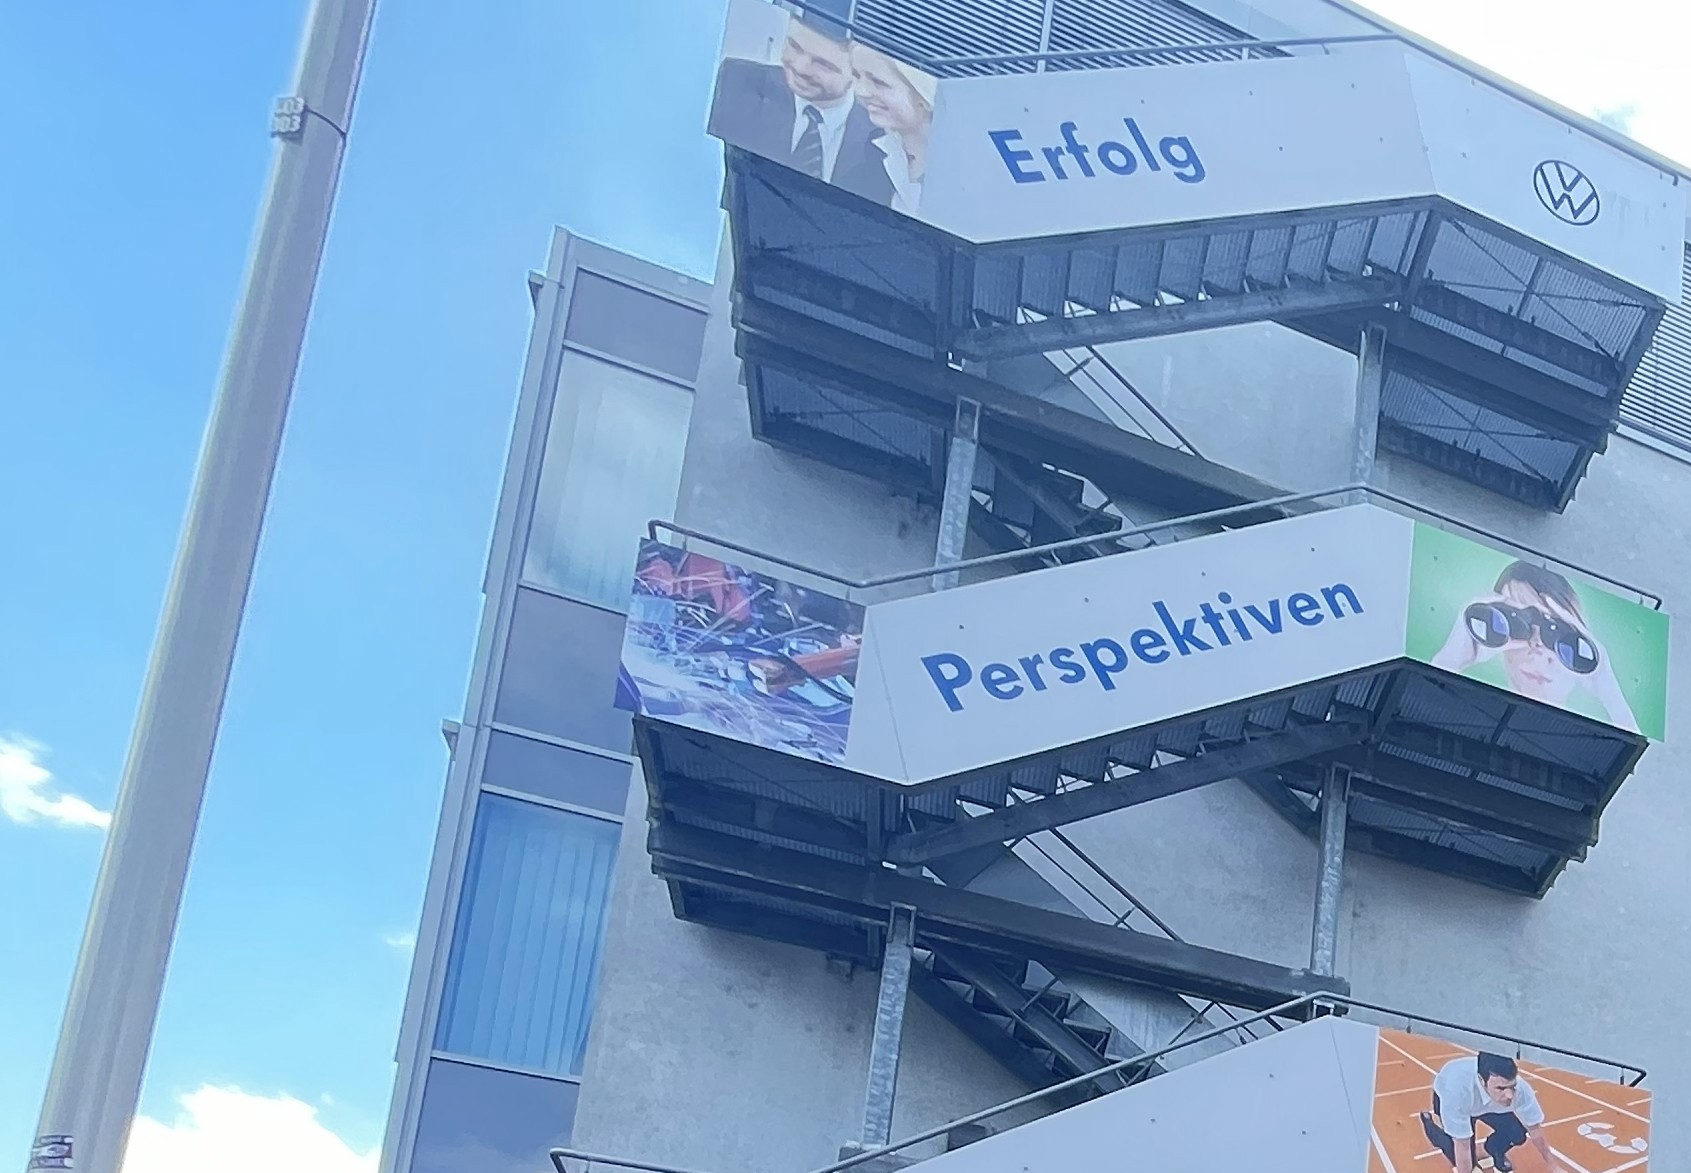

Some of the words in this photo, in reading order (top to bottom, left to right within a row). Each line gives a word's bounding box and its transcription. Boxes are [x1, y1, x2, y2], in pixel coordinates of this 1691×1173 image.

[988, 115, 1207, 185] Erfolg
[1533, 158, 1600, 225] VW
[921, 583, 1364, 713] Perspektiven
